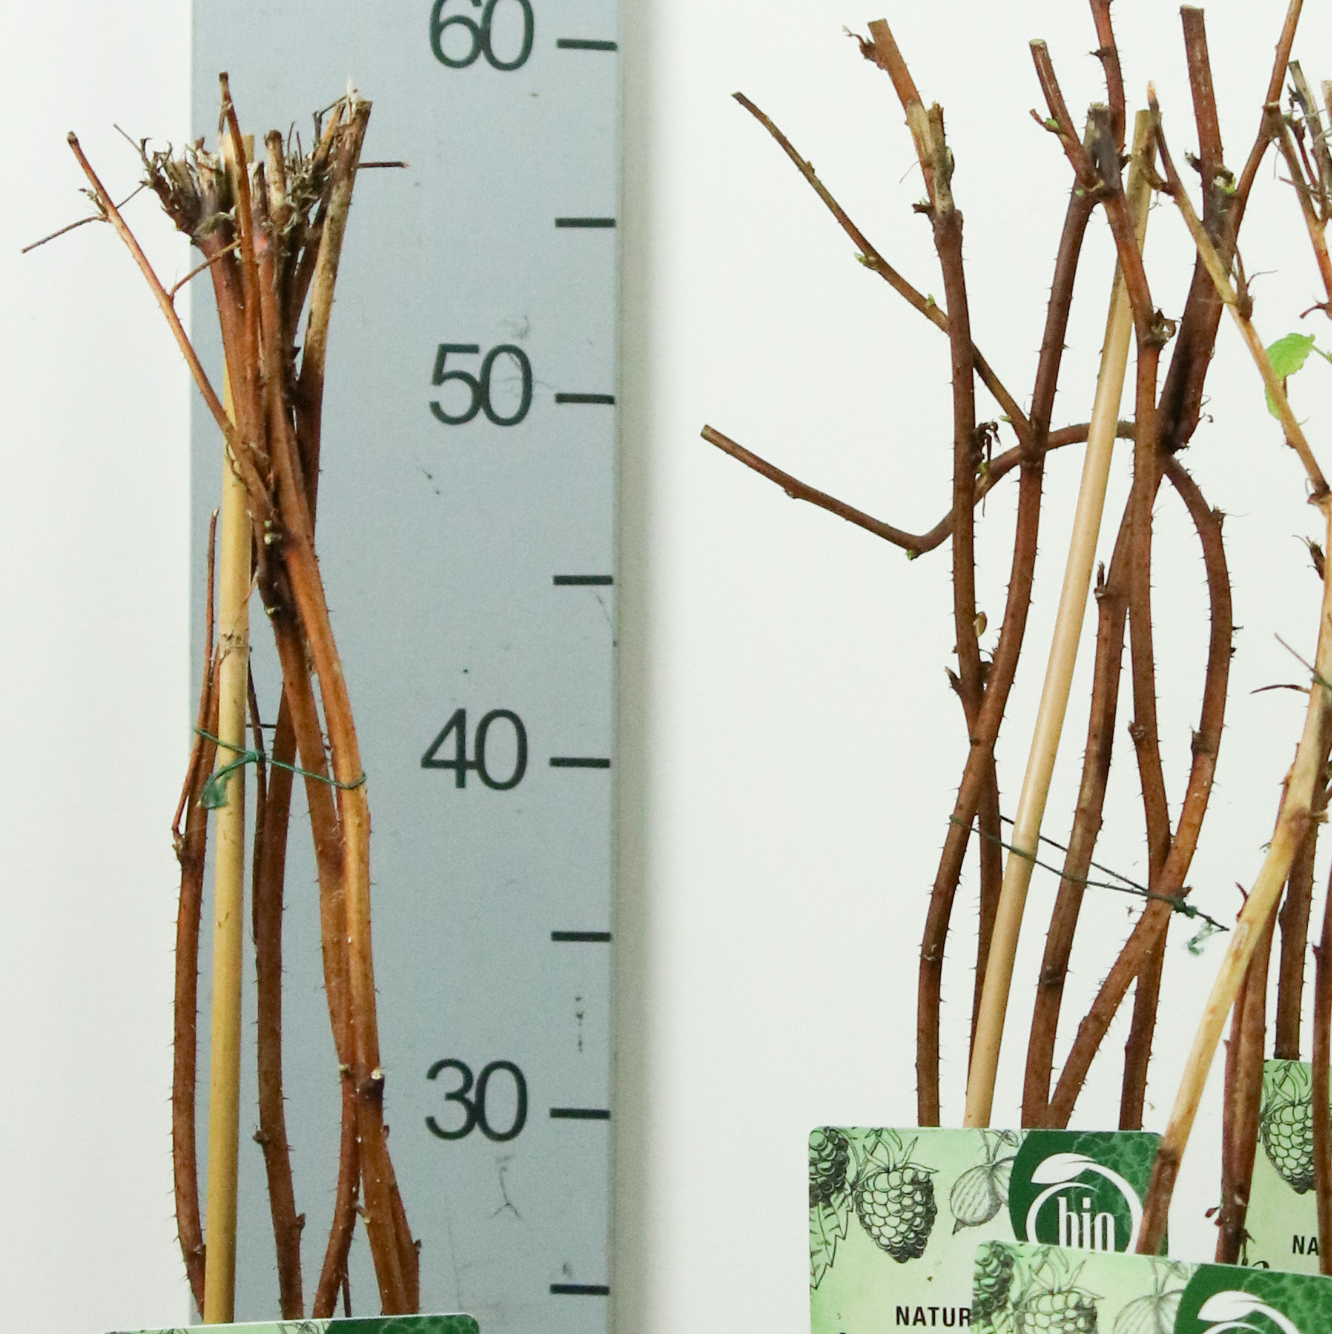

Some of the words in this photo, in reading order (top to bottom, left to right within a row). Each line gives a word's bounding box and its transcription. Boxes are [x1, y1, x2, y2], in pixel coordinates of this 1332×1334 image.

[427, 342, 534, 427] 50
[420, 707, 529, 791] 40
[423, 1057, 529, 1144] 30
